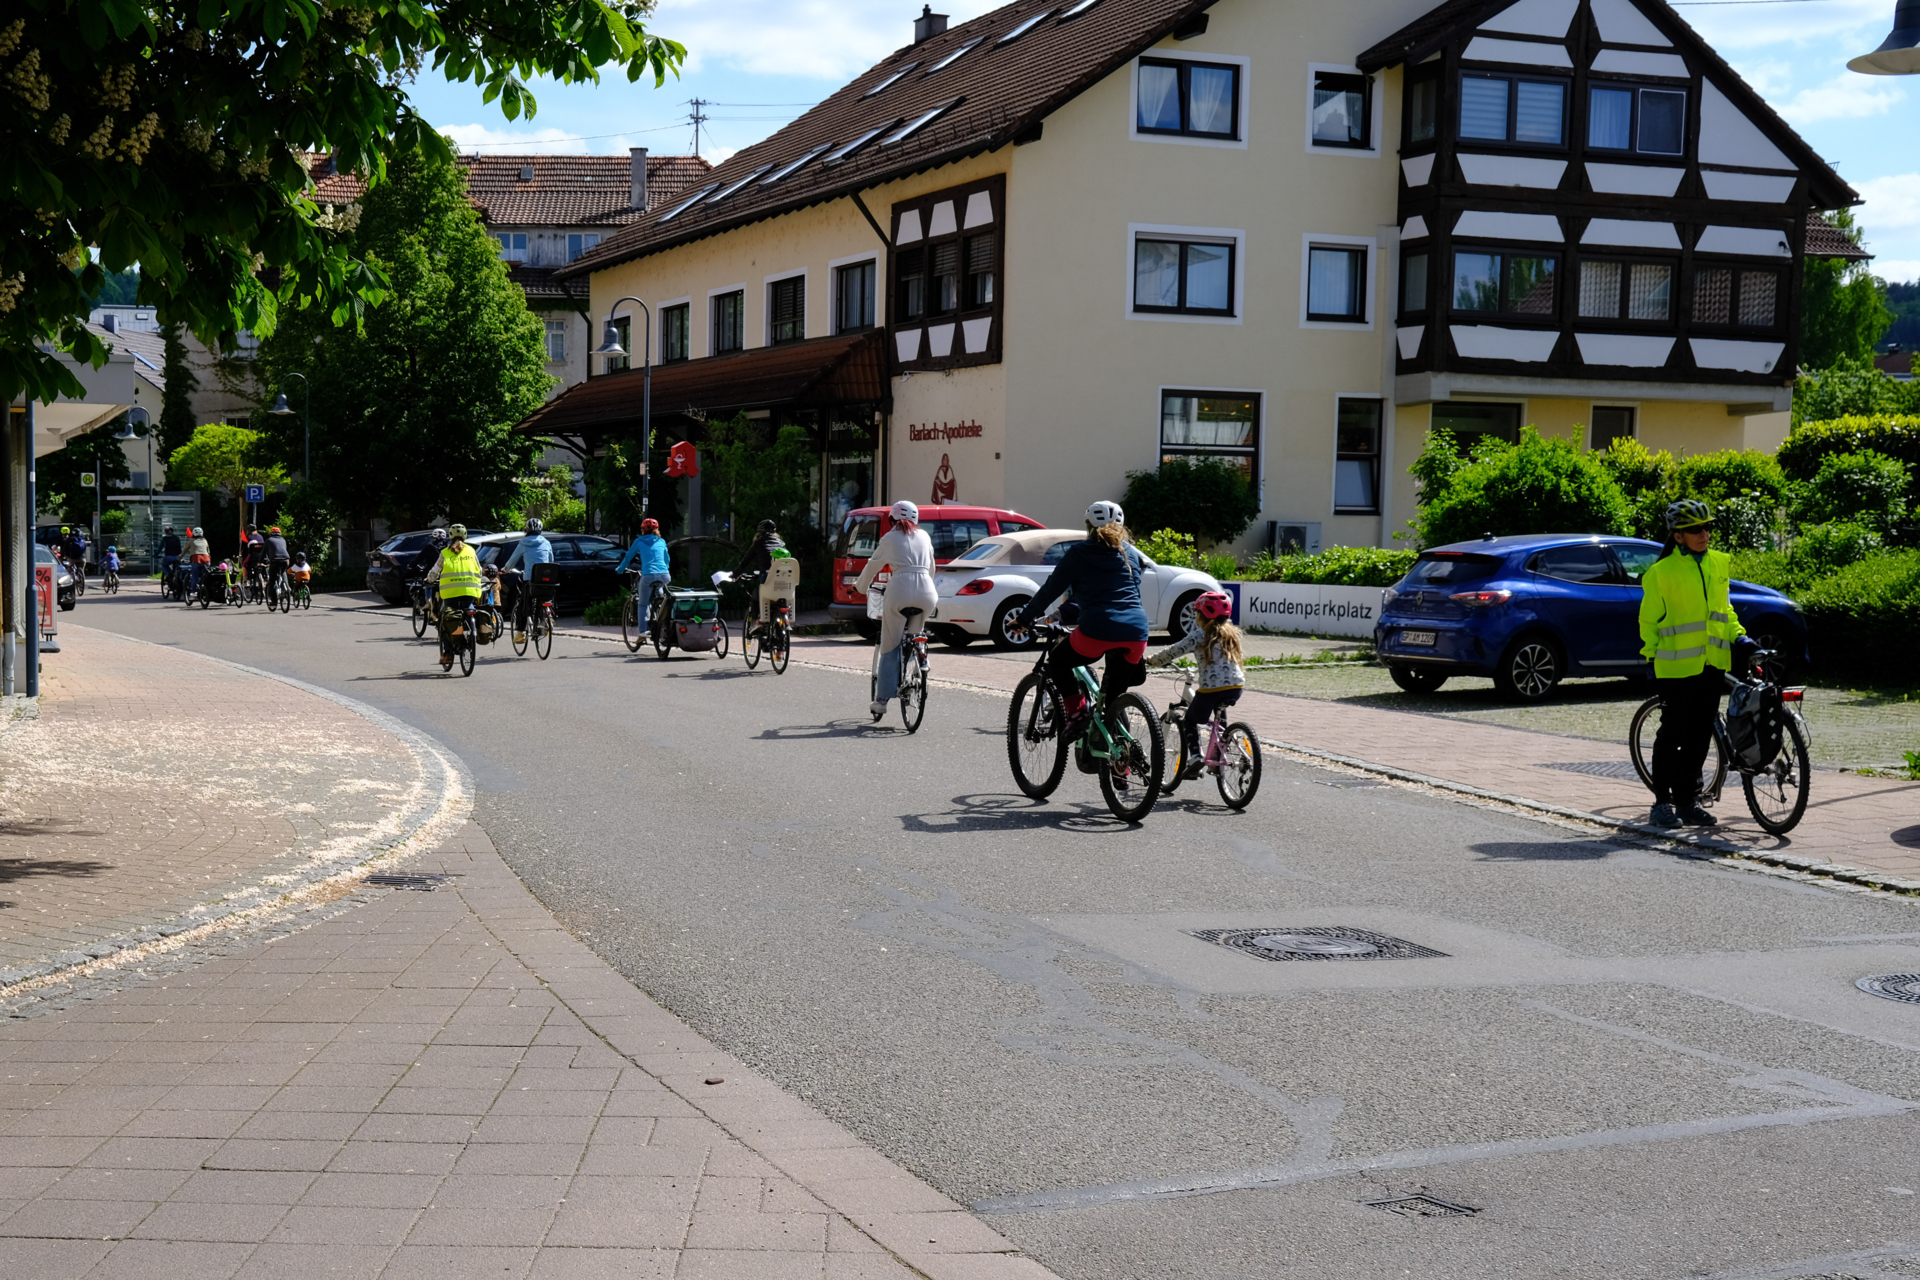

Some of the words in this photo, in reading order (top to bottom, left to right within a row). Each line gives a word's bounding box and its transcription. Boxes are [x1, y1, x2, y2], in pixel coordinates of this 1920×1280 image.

[909, 419, 982, 444] Barlach-Apotheke
[250, 488, 259, 500] P
[1249, 596, 1372, 621] Kundenparkplatz
